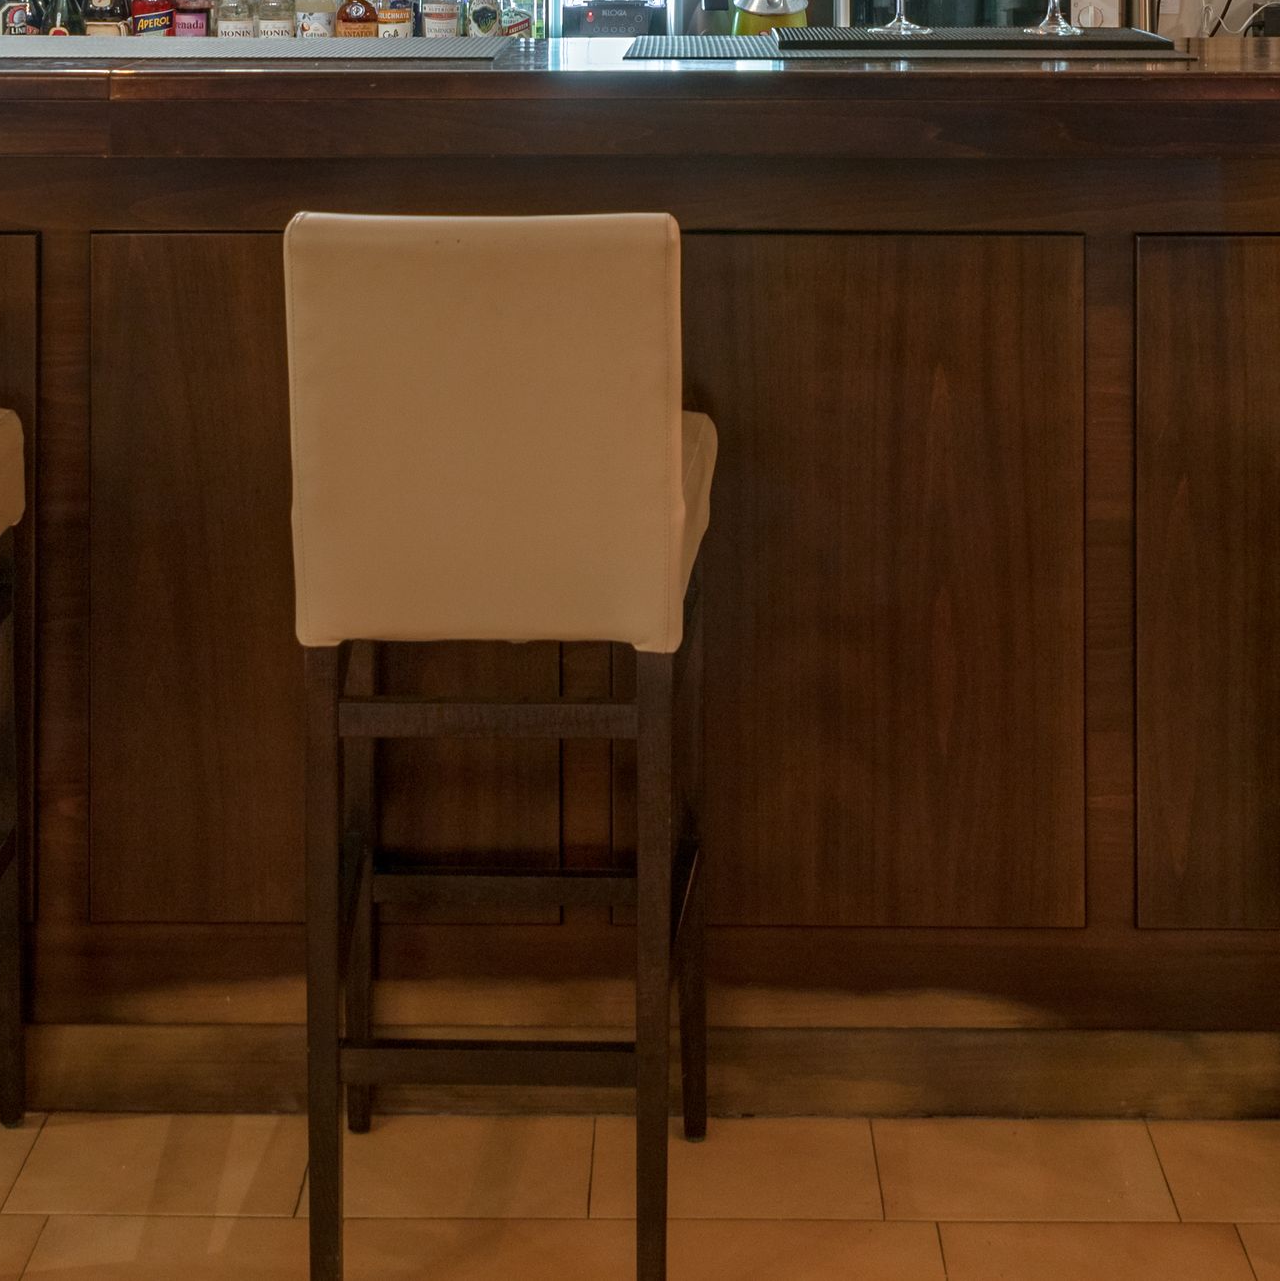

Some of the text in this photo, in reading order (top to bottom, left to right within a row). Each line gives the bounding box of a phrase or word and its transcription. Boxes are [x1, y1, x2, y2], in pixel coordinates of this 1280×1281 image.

[137, 16, 170, 31] APEROL
[176, 19, 205, 30] renada
[260, 29, 290, 37] MONIN
